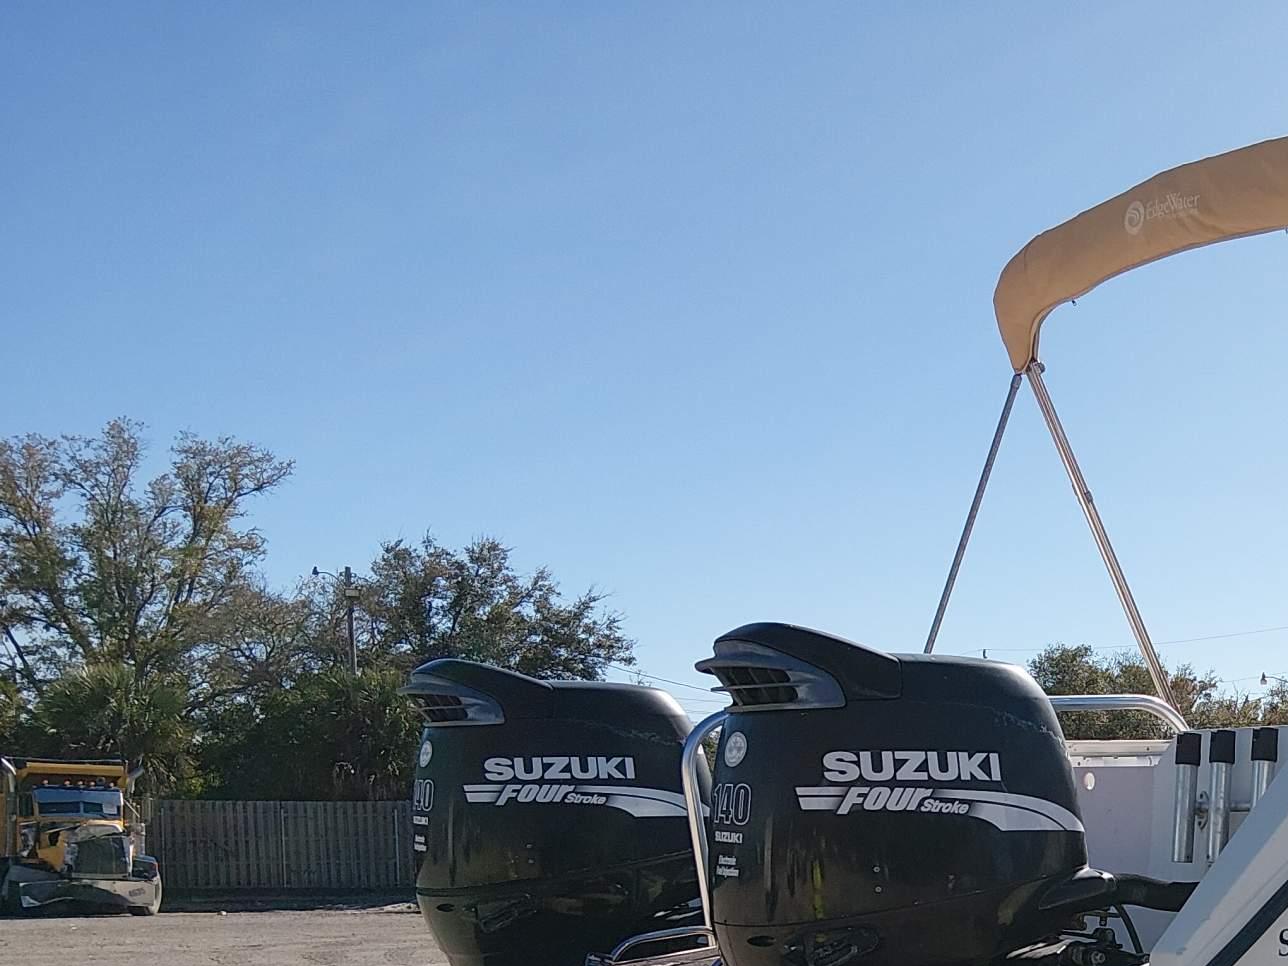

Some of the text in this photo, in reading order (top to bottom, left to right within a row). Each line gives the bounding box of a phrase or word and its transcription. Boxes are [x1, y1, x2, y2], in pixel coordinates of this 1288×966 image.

[484, 756, 636, 782] SUZUKI
[822, 750, 1002, 782] SUZUKI
[564, 792, 607, 806] Stroke
[713, 783, 751, 825] 140
[920, 798, 970, 815] Stroke
[714, 831, 743, 844] SUZUKI
